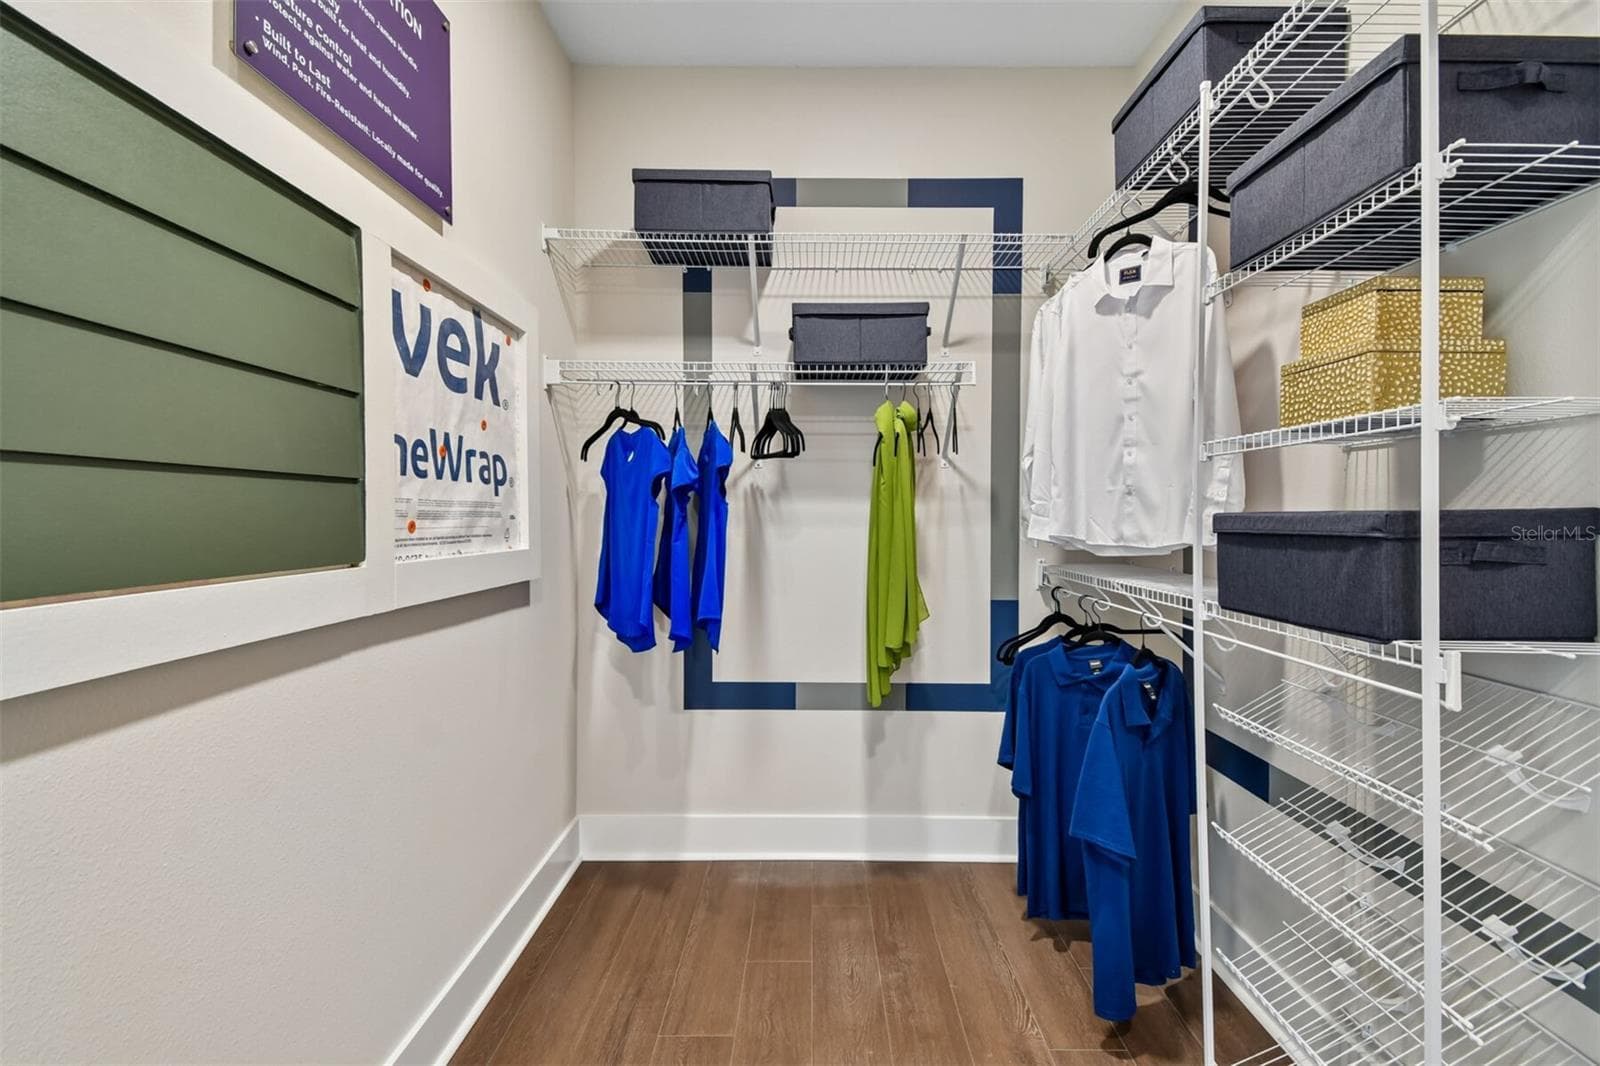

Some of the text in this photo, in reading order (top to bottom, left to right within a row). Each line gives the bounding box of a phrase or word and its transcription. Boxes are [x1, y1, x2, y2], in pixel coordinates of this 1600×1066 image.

[263, 18, 331, 89] Built to Last
[315, 23, 353, 68] Control
[376, 20, 397, 47] James
[389, 0, 422, 40] TION
[303, 29, 335, 63] against
[335, 59, 358, 84] water
[358, 81, 373, 99] and
[373, 92, 393, 118] harsh
[392, 113, 420, 143] weather.
[338, 18, 349, 35] for
[351, 31, 367, 55] heat
[368, 51, 381, 69] and
[381, 63, 412, 99] humidity.
[261, 34, 290, 69] Wind,
[292, 61, 314, 89] Pest,
[371, 131, 396, 159] Locally
[396, 153, 414, 173] made
[414, 167, 424, 180] for
